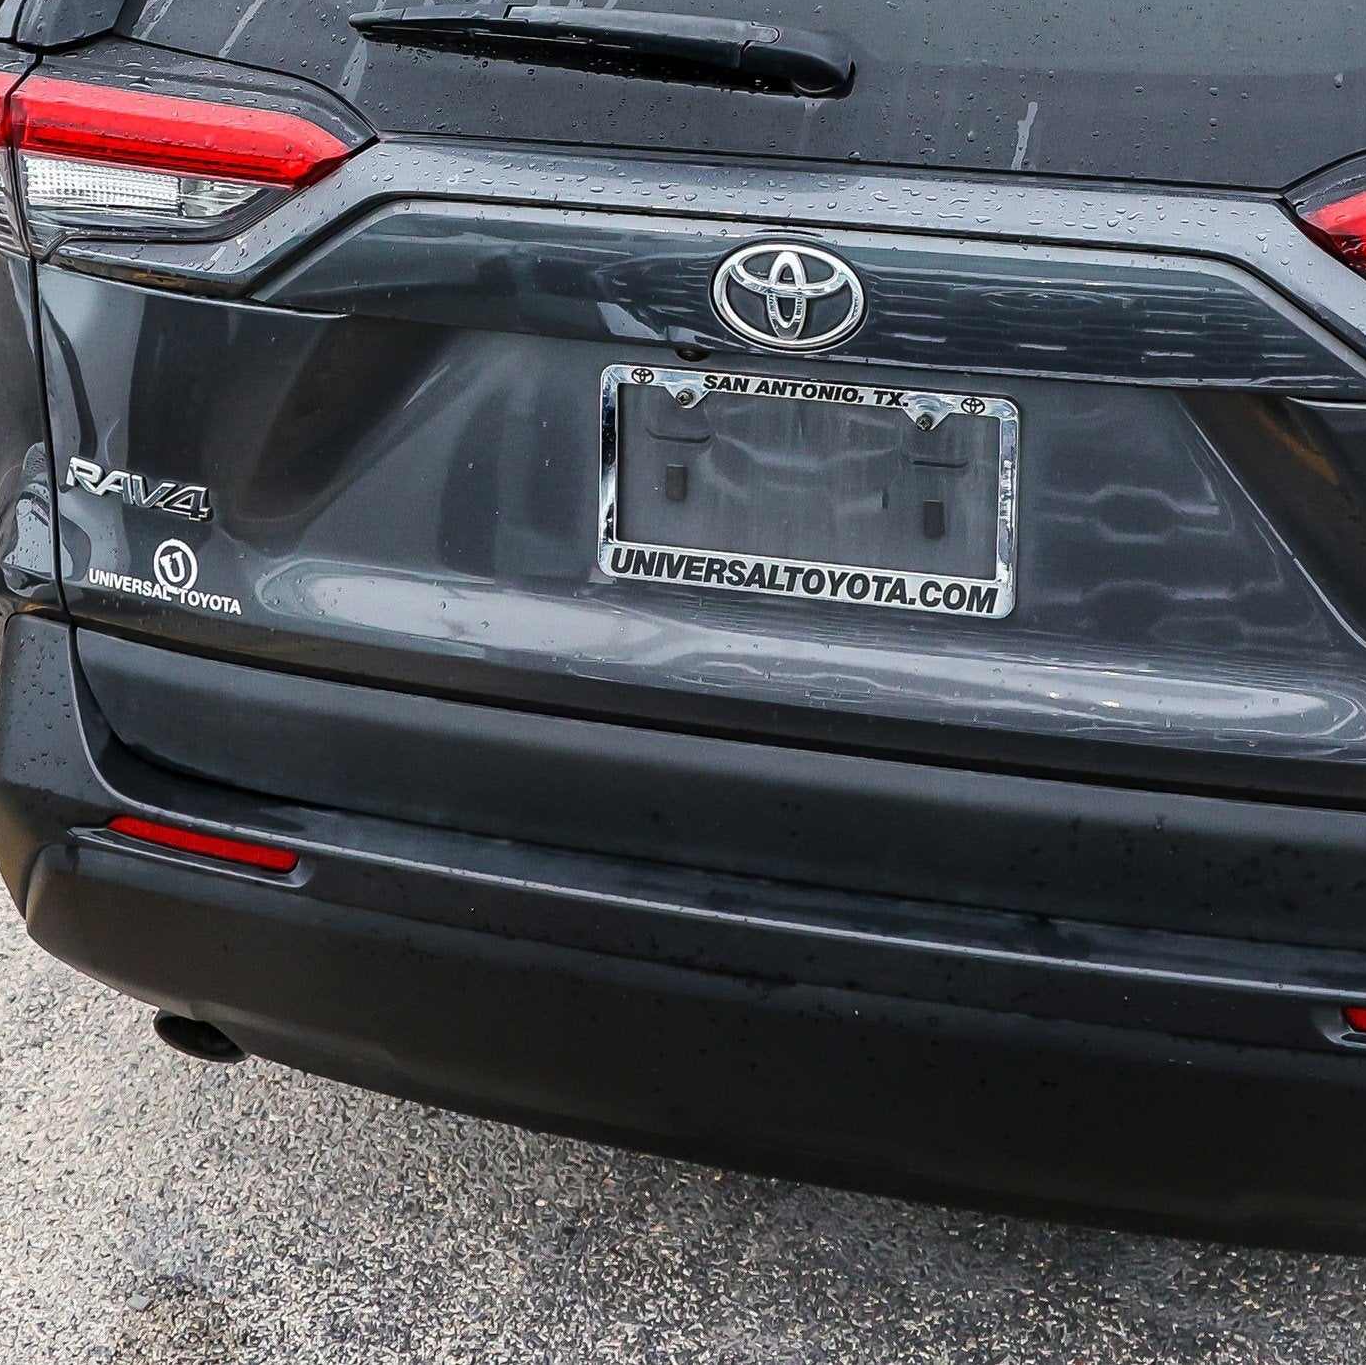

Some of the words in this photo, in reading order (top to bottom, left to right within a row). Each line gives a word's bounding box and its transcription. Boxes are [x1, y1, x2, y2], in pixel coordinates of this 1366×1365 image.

[703, 375, 751, 392] SAN
[754, 379, 865, 405] ANTONIO,
[874, 391, 910, 408] TX.
[65, 456, 210, 521] RAV4
[159, 549, 187, 584] U
[611, 548, 999, 614] UNIVERSALTOYOTA.COM
[88, 567, 172, 602] UNIVERSAL
[179, 588, 242, 616] TOYOTA
